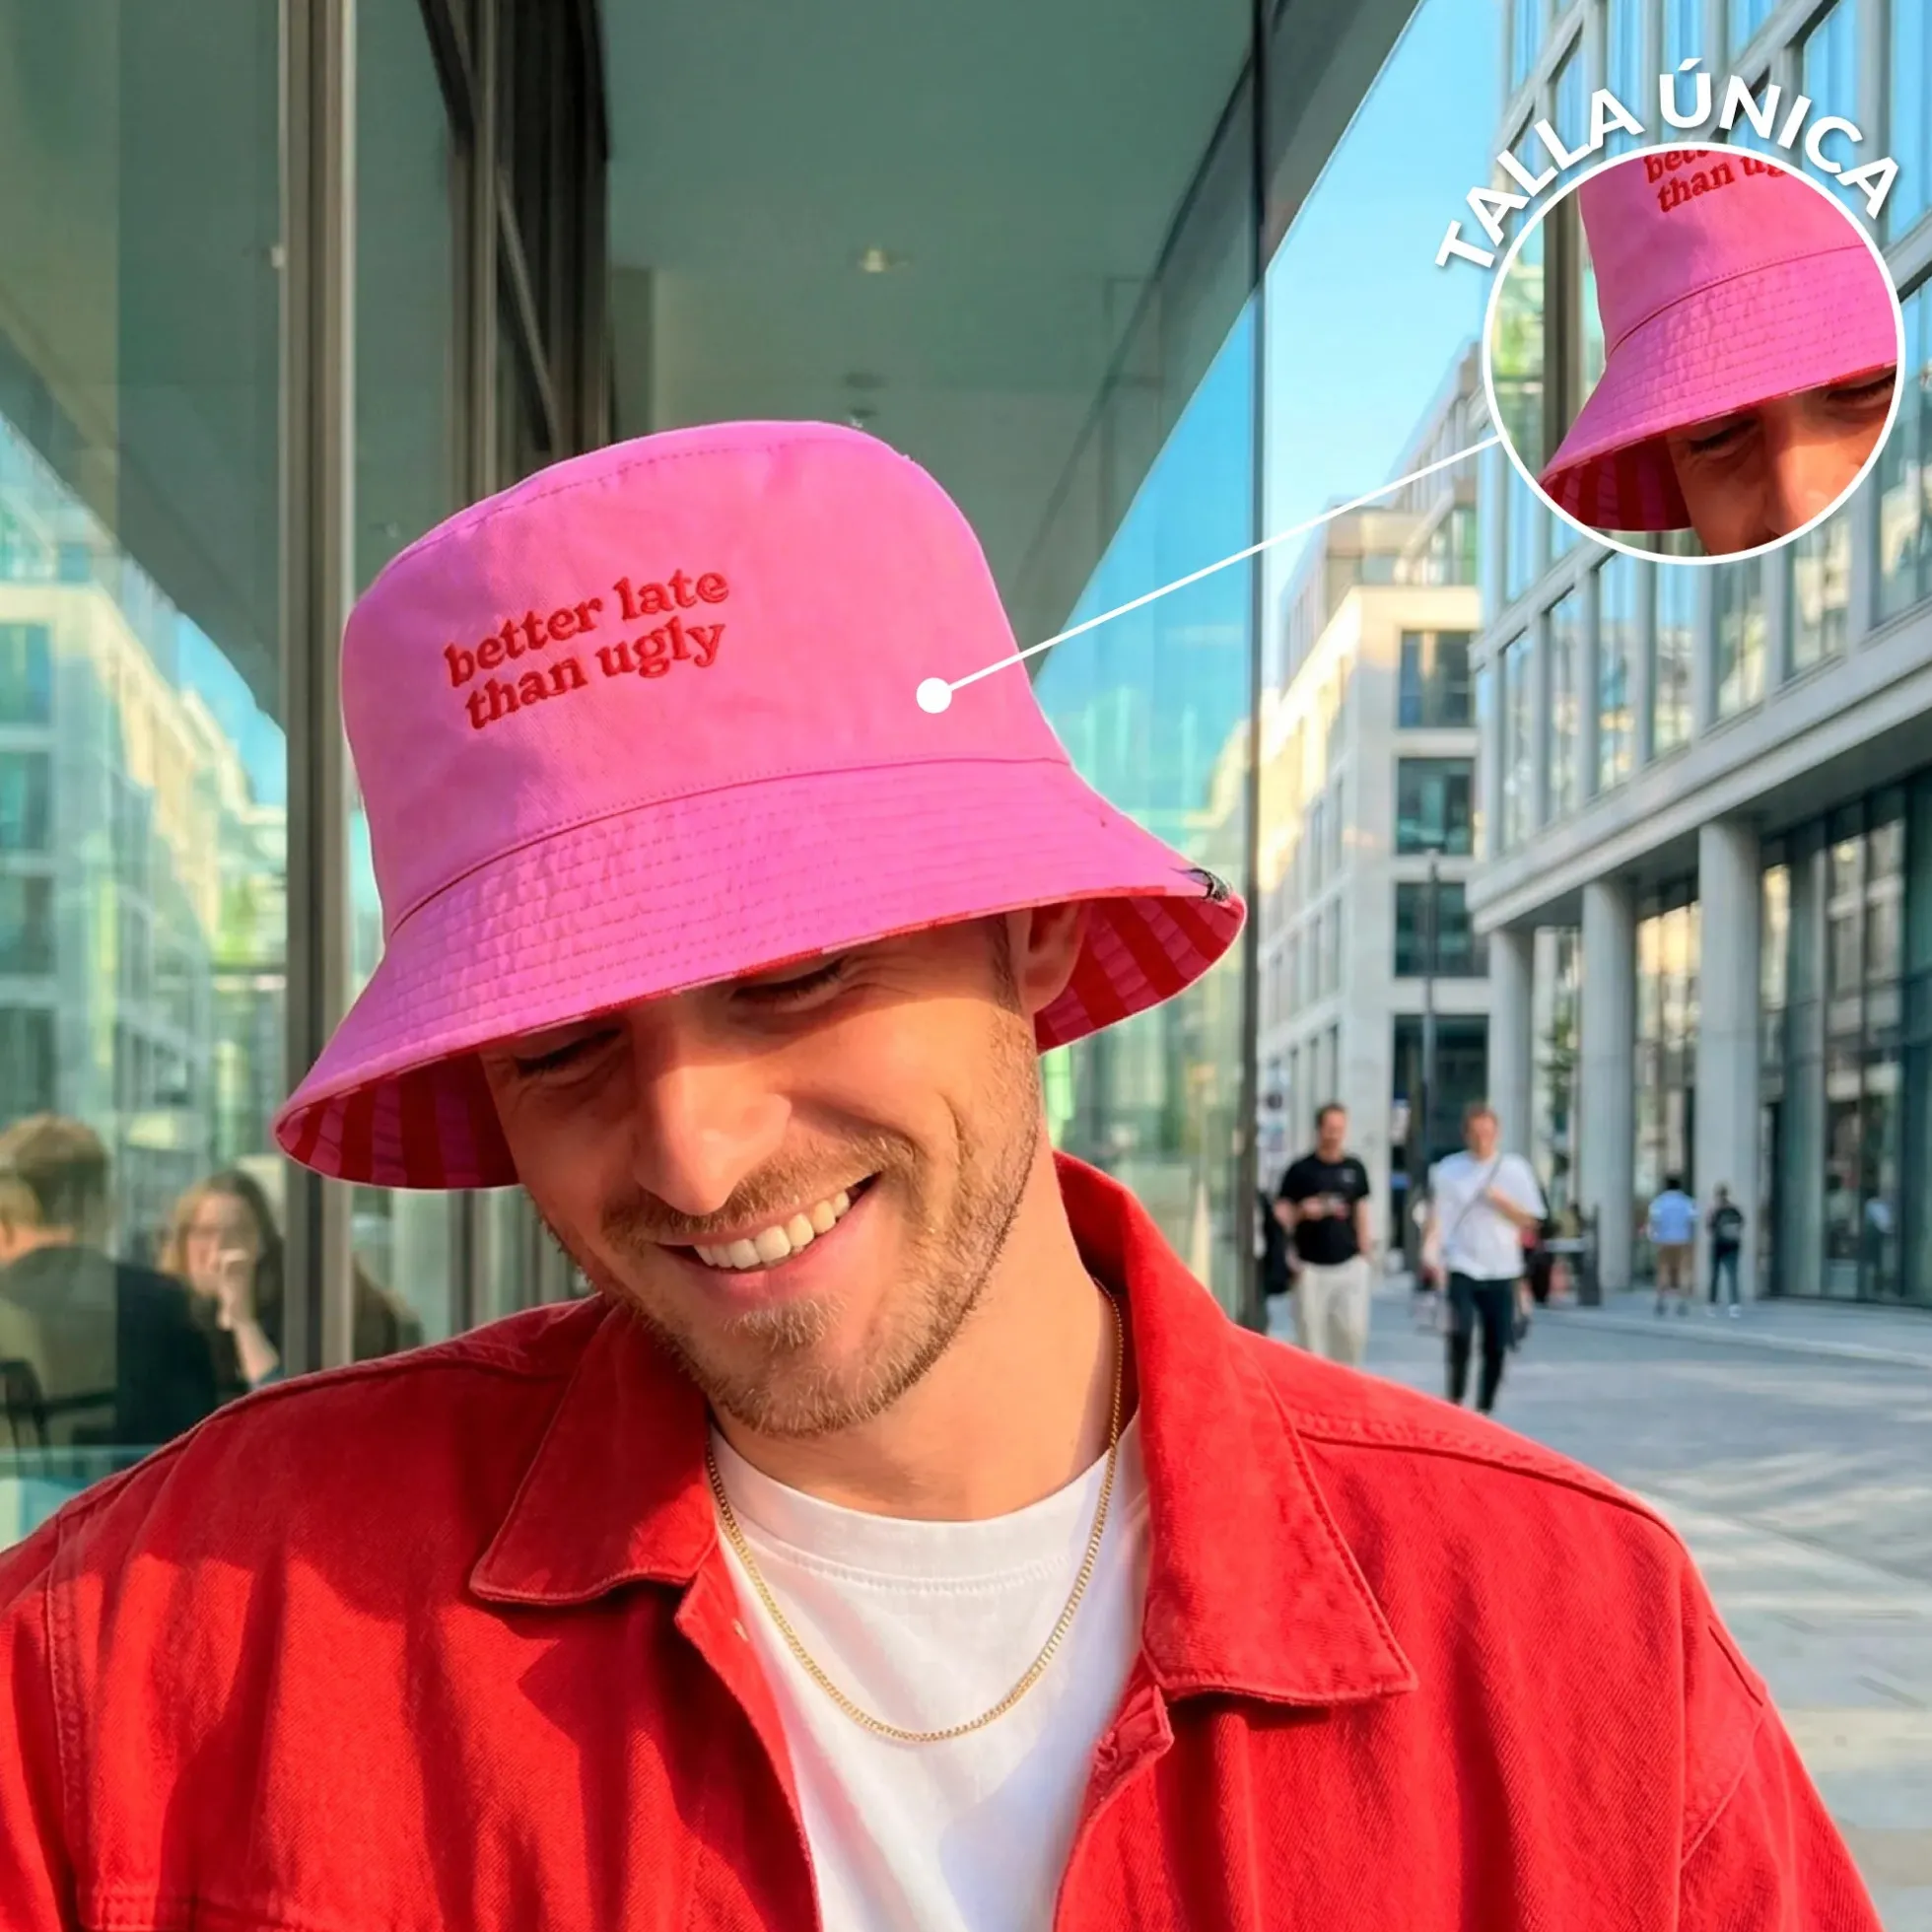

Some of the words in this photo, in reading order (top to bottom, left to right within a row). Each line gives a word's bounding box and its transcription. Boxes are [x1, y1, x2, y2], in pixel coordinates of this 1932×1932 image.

[1657, 162, 1735, 213] than
[443, 597, 604, 688] better
[612, 568, 729, 622] late
[464, 656, 589, 730] than
[594, 615, 726, 679] ugly
